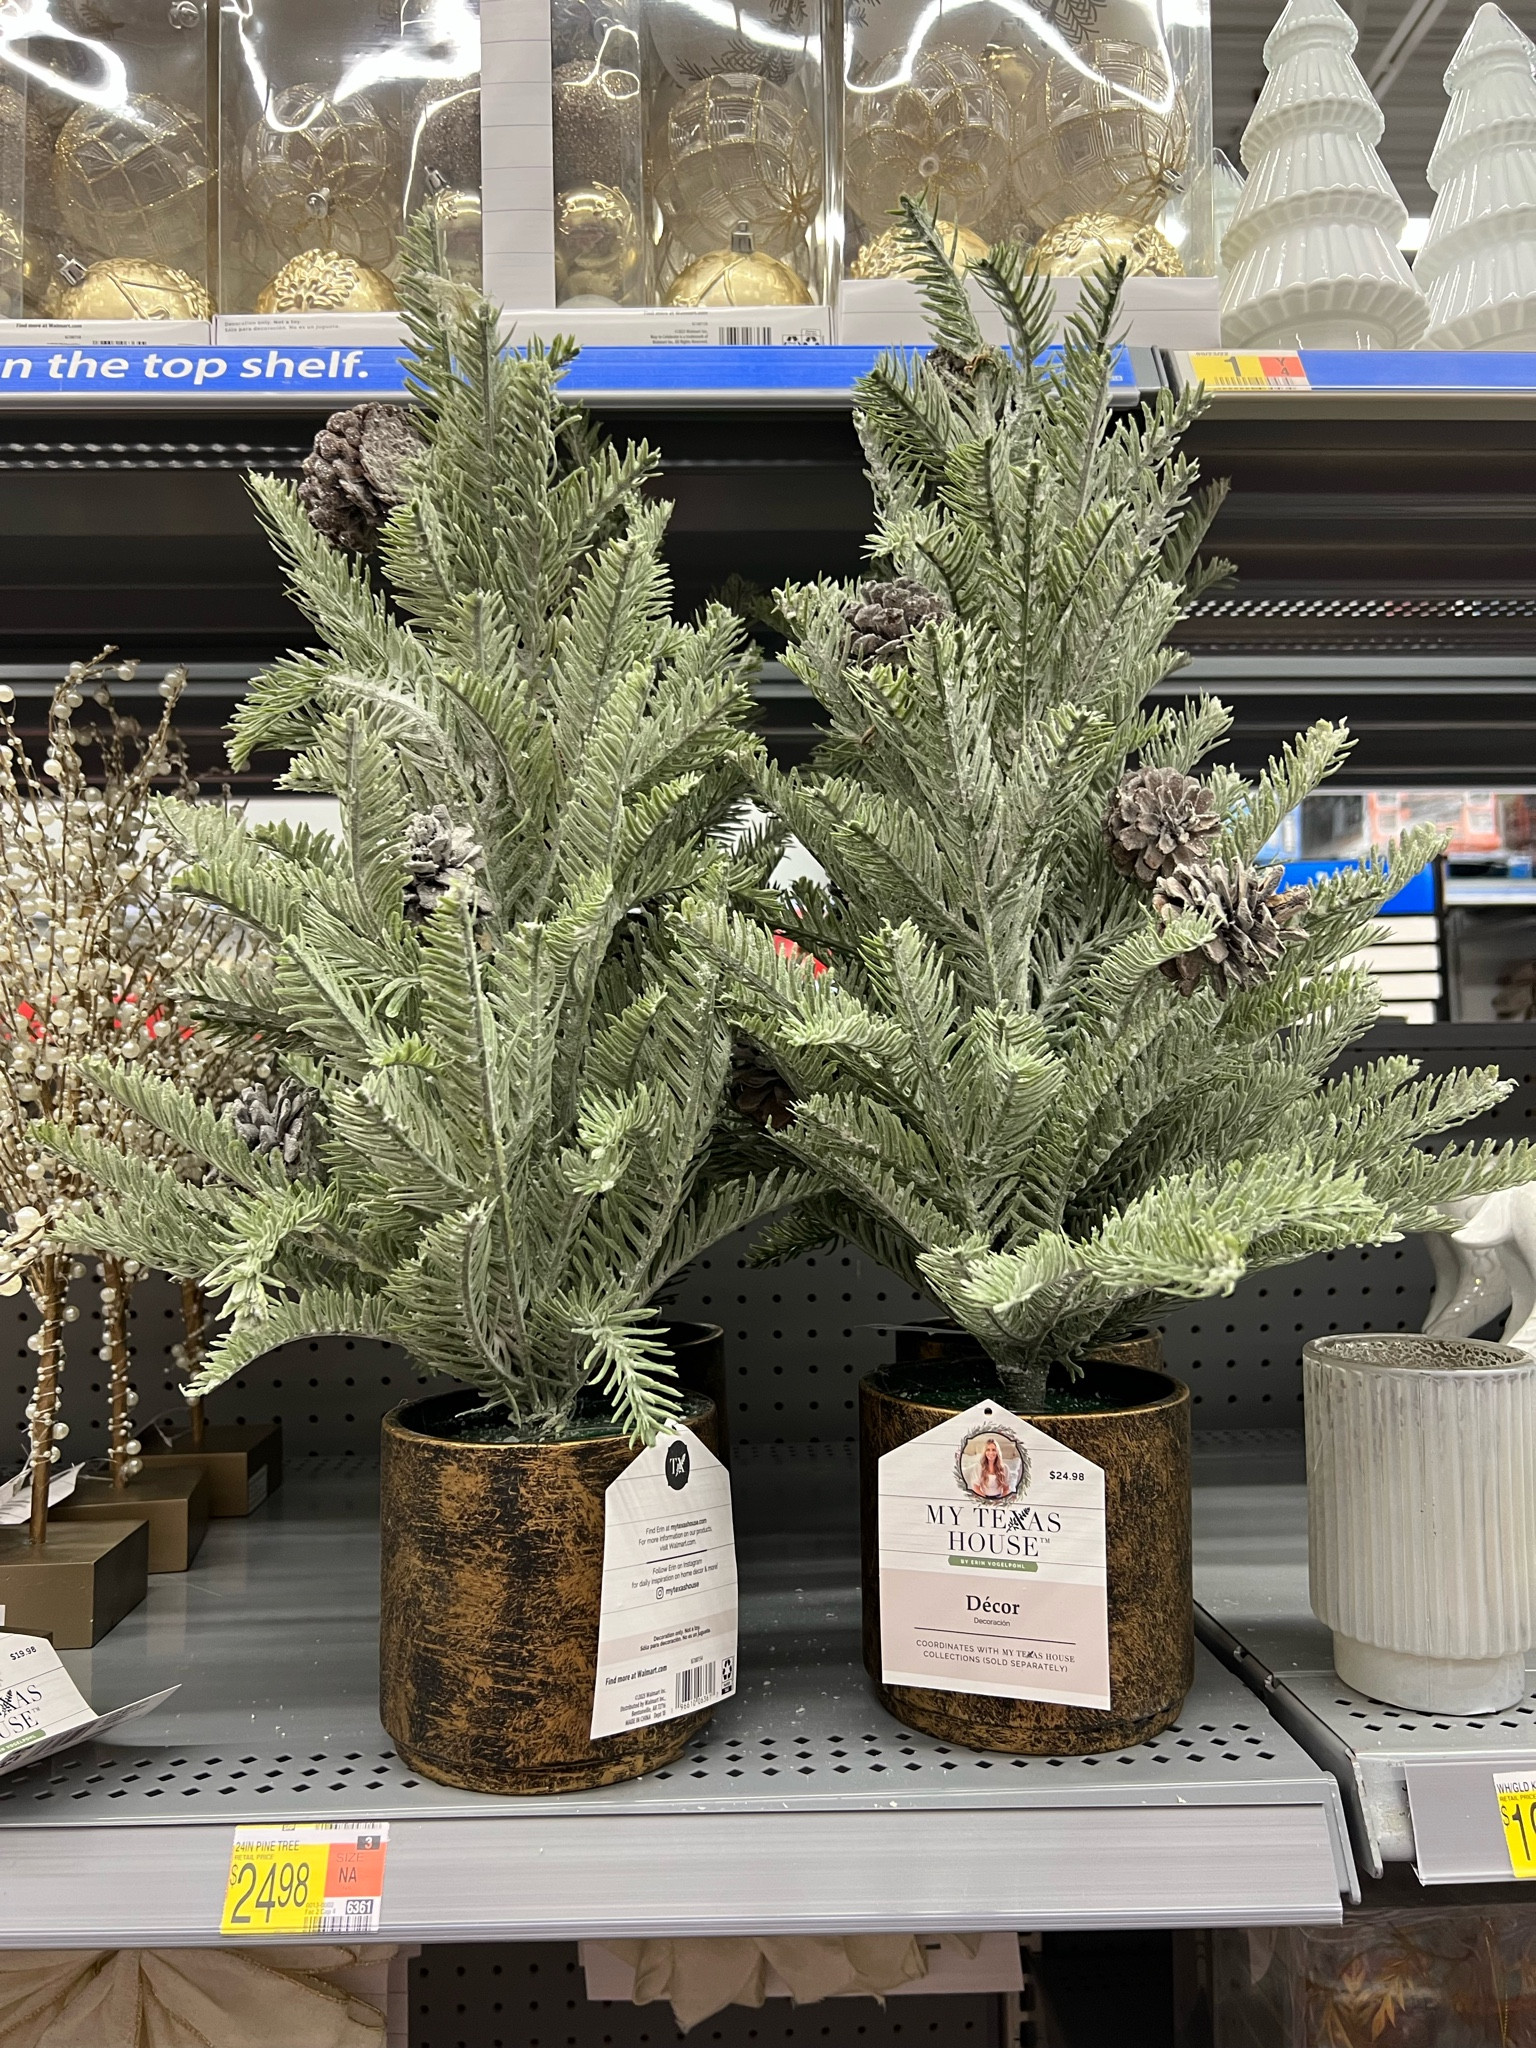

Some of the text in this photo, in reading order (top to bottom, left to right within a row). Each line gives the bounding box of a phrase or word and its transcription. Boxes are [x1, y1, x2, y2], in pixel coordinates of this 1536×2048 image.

[48, 350, 129, 379] the
[143, 353, 228, 385] top
[240, 350, 369, 379] shelf.
[1224, 356, 1242, 377] 1
[1049, 1470, 1085, 1481] $24.98
[925, 1504, 1062, 1533] MY TEXAS
[646, 1526, 656, 1535] Find
[656, 1526, 665, 1534] Erin
[670, 1518, 707, 1532] mytexashouse.com
[638, 1538, 647, 1546] For
[647, 1536, 659, 1545] more
[660, 1532, 683, 1542] information
[660, 1544, 669, 1552] visit
[652, 1566, 668, 1575] Follow
[668, 1564, 677, 1572] Erin
[684, 1559, 703, 1569] Instagram
[988, 1561, 1026, 1569] VOGELPOHL
[639, 1578, 651, 1587] daily
[651, 1574, 674, 1585] inspiration
[681, 1570, 693, 1578] home
[708, 1562, 719, 1572] more!
[666, 1582, 700, 1596] mytexashouse
[966, 1594, 1021, 1615] Décor
[974, 1616, 1011, 1627] Decoración
[654, 1632, 675, 1642] Decoration
[650, 1642, 660, 1650] para
[916, 1639, 1076, 1663] COORDINATES WITH MY TEXAS HOUSE
[10, 1646, 37, 1661] $19.98
[923, 1650, 1069, 1673] COLLECTIONS (SOLD SEPARATELY)
[605, 1665, 668, 1686] Find more at Walmart.com
[647, 1689, 661, 1698] Walmart
[620, 1702, 640, 1713] Distributed
[645, 1698, 659, 1706] Walmart
[626, 1718, 636, 1726] MADE
[641, 1714, 652, 1722] CHINA
[1496, 1781, 1530, 1794] WH/GLD
[235, 1840, 300, 1853] 24IN PINE TREE
[364, 1836, 373, 1849] 3
[336, 1852, 364, 1863] SIZE
[339, 1866, 357, 1883] NA
[346, 1900, 373, 1914] 6361
